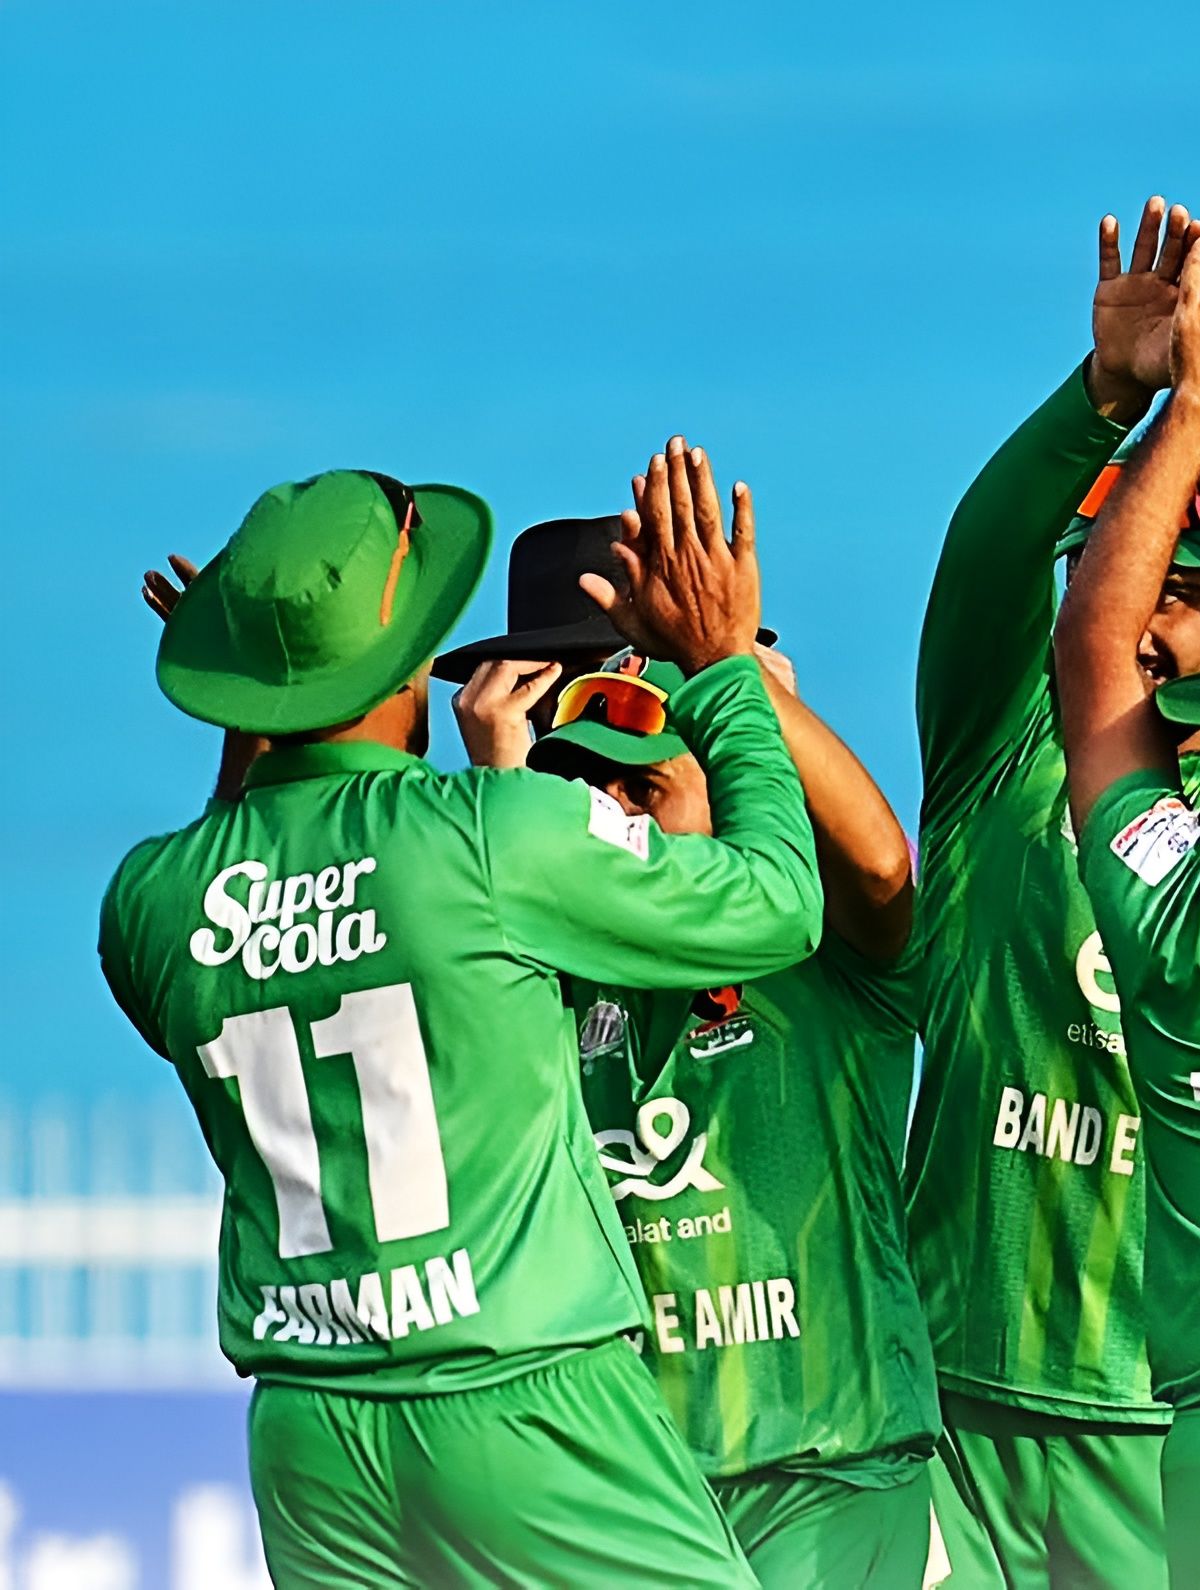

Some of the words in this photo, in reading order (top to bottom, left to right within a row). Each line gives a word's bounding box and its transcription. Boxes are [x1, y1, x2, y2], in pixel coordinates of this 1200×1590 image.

[190, 857, 377, 966] Super
[242, 909, 387, 980] cola
[196, 982, 450, 1259] 11
[993, 1086, 1102, 1166] BAND
[1110, 1113, 1141, 1176] E
[677, 1206, 732, 1239] and
[253, 1248, 481, 1345] FARMAN
[653, 1293, 685, 1354] E
[695, 1277, 800, 1349] AMIR
